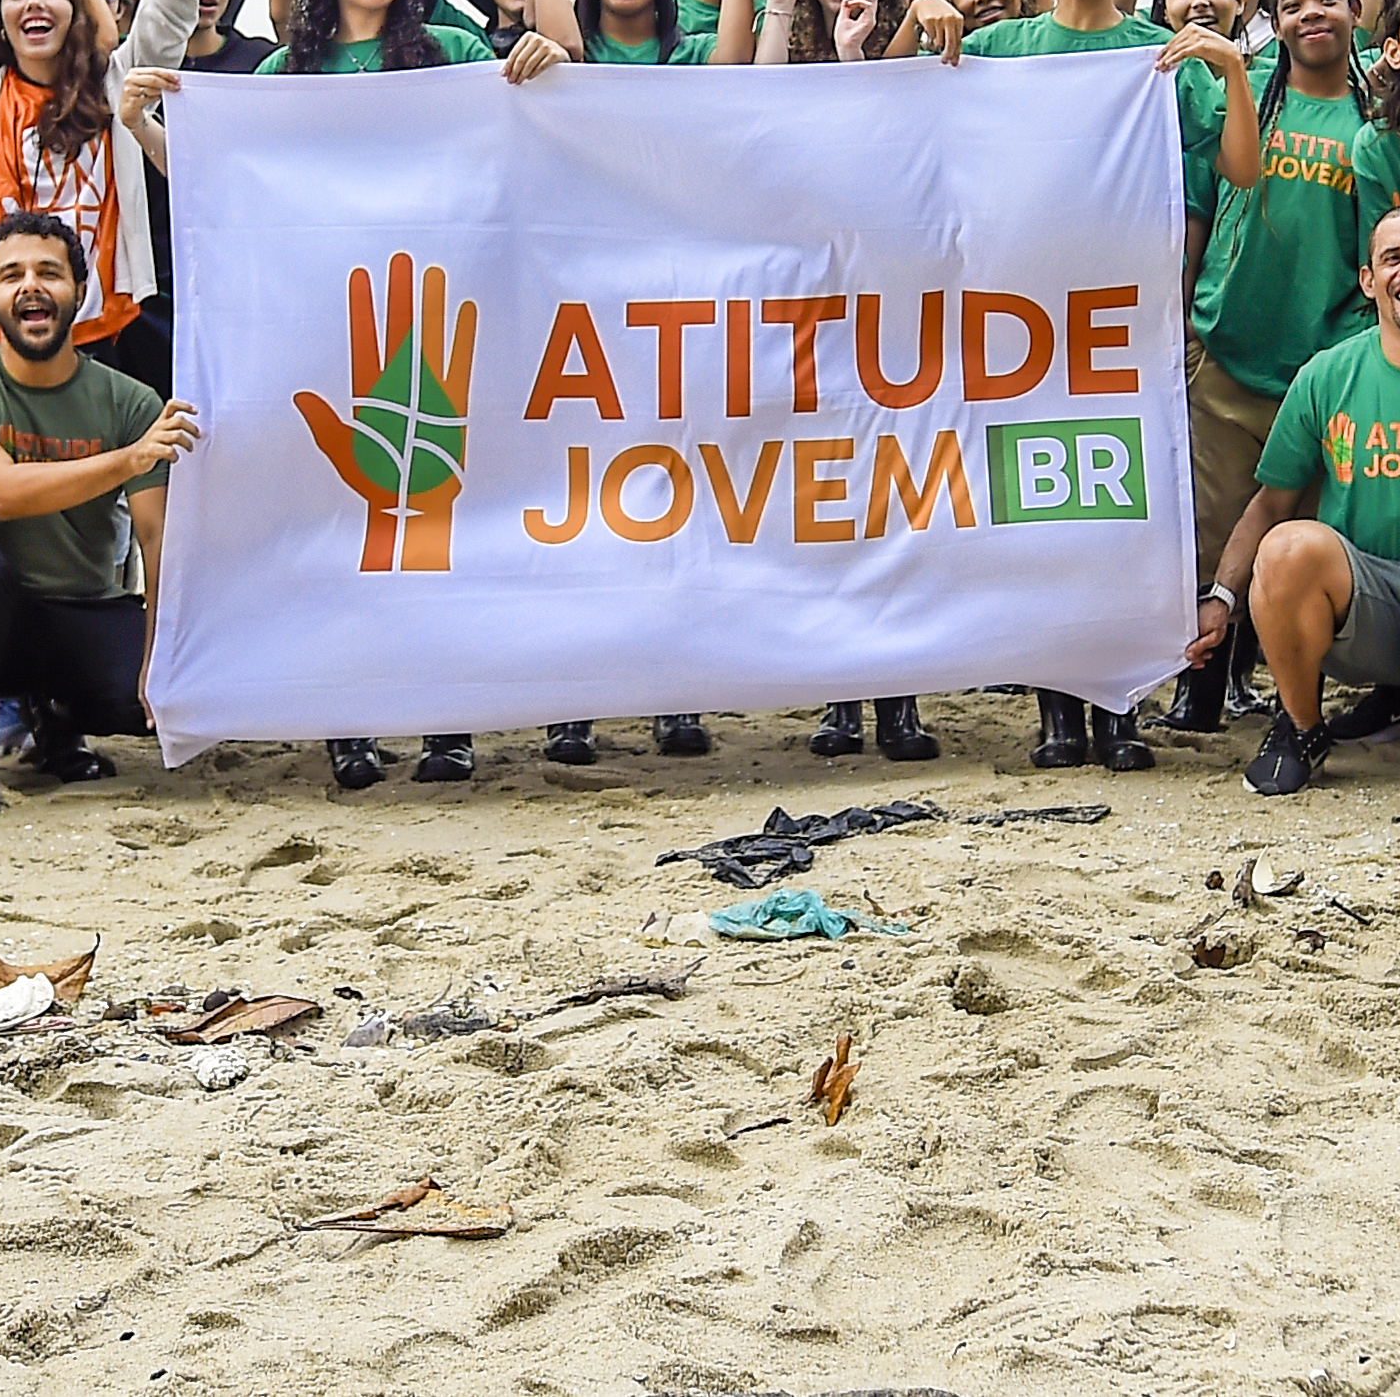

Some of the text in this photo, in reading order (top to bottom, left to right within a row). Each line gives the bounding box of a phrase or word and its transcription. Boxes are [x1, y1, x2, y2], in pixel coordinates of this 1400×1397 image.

[1265, 155, 1354, 195] JOVEM
[1269, 129, 1352, 167] ATITU
[523, 284, 1140, 420] ATITUDE
[523, 430, 1135, 545] JOVEM BR
